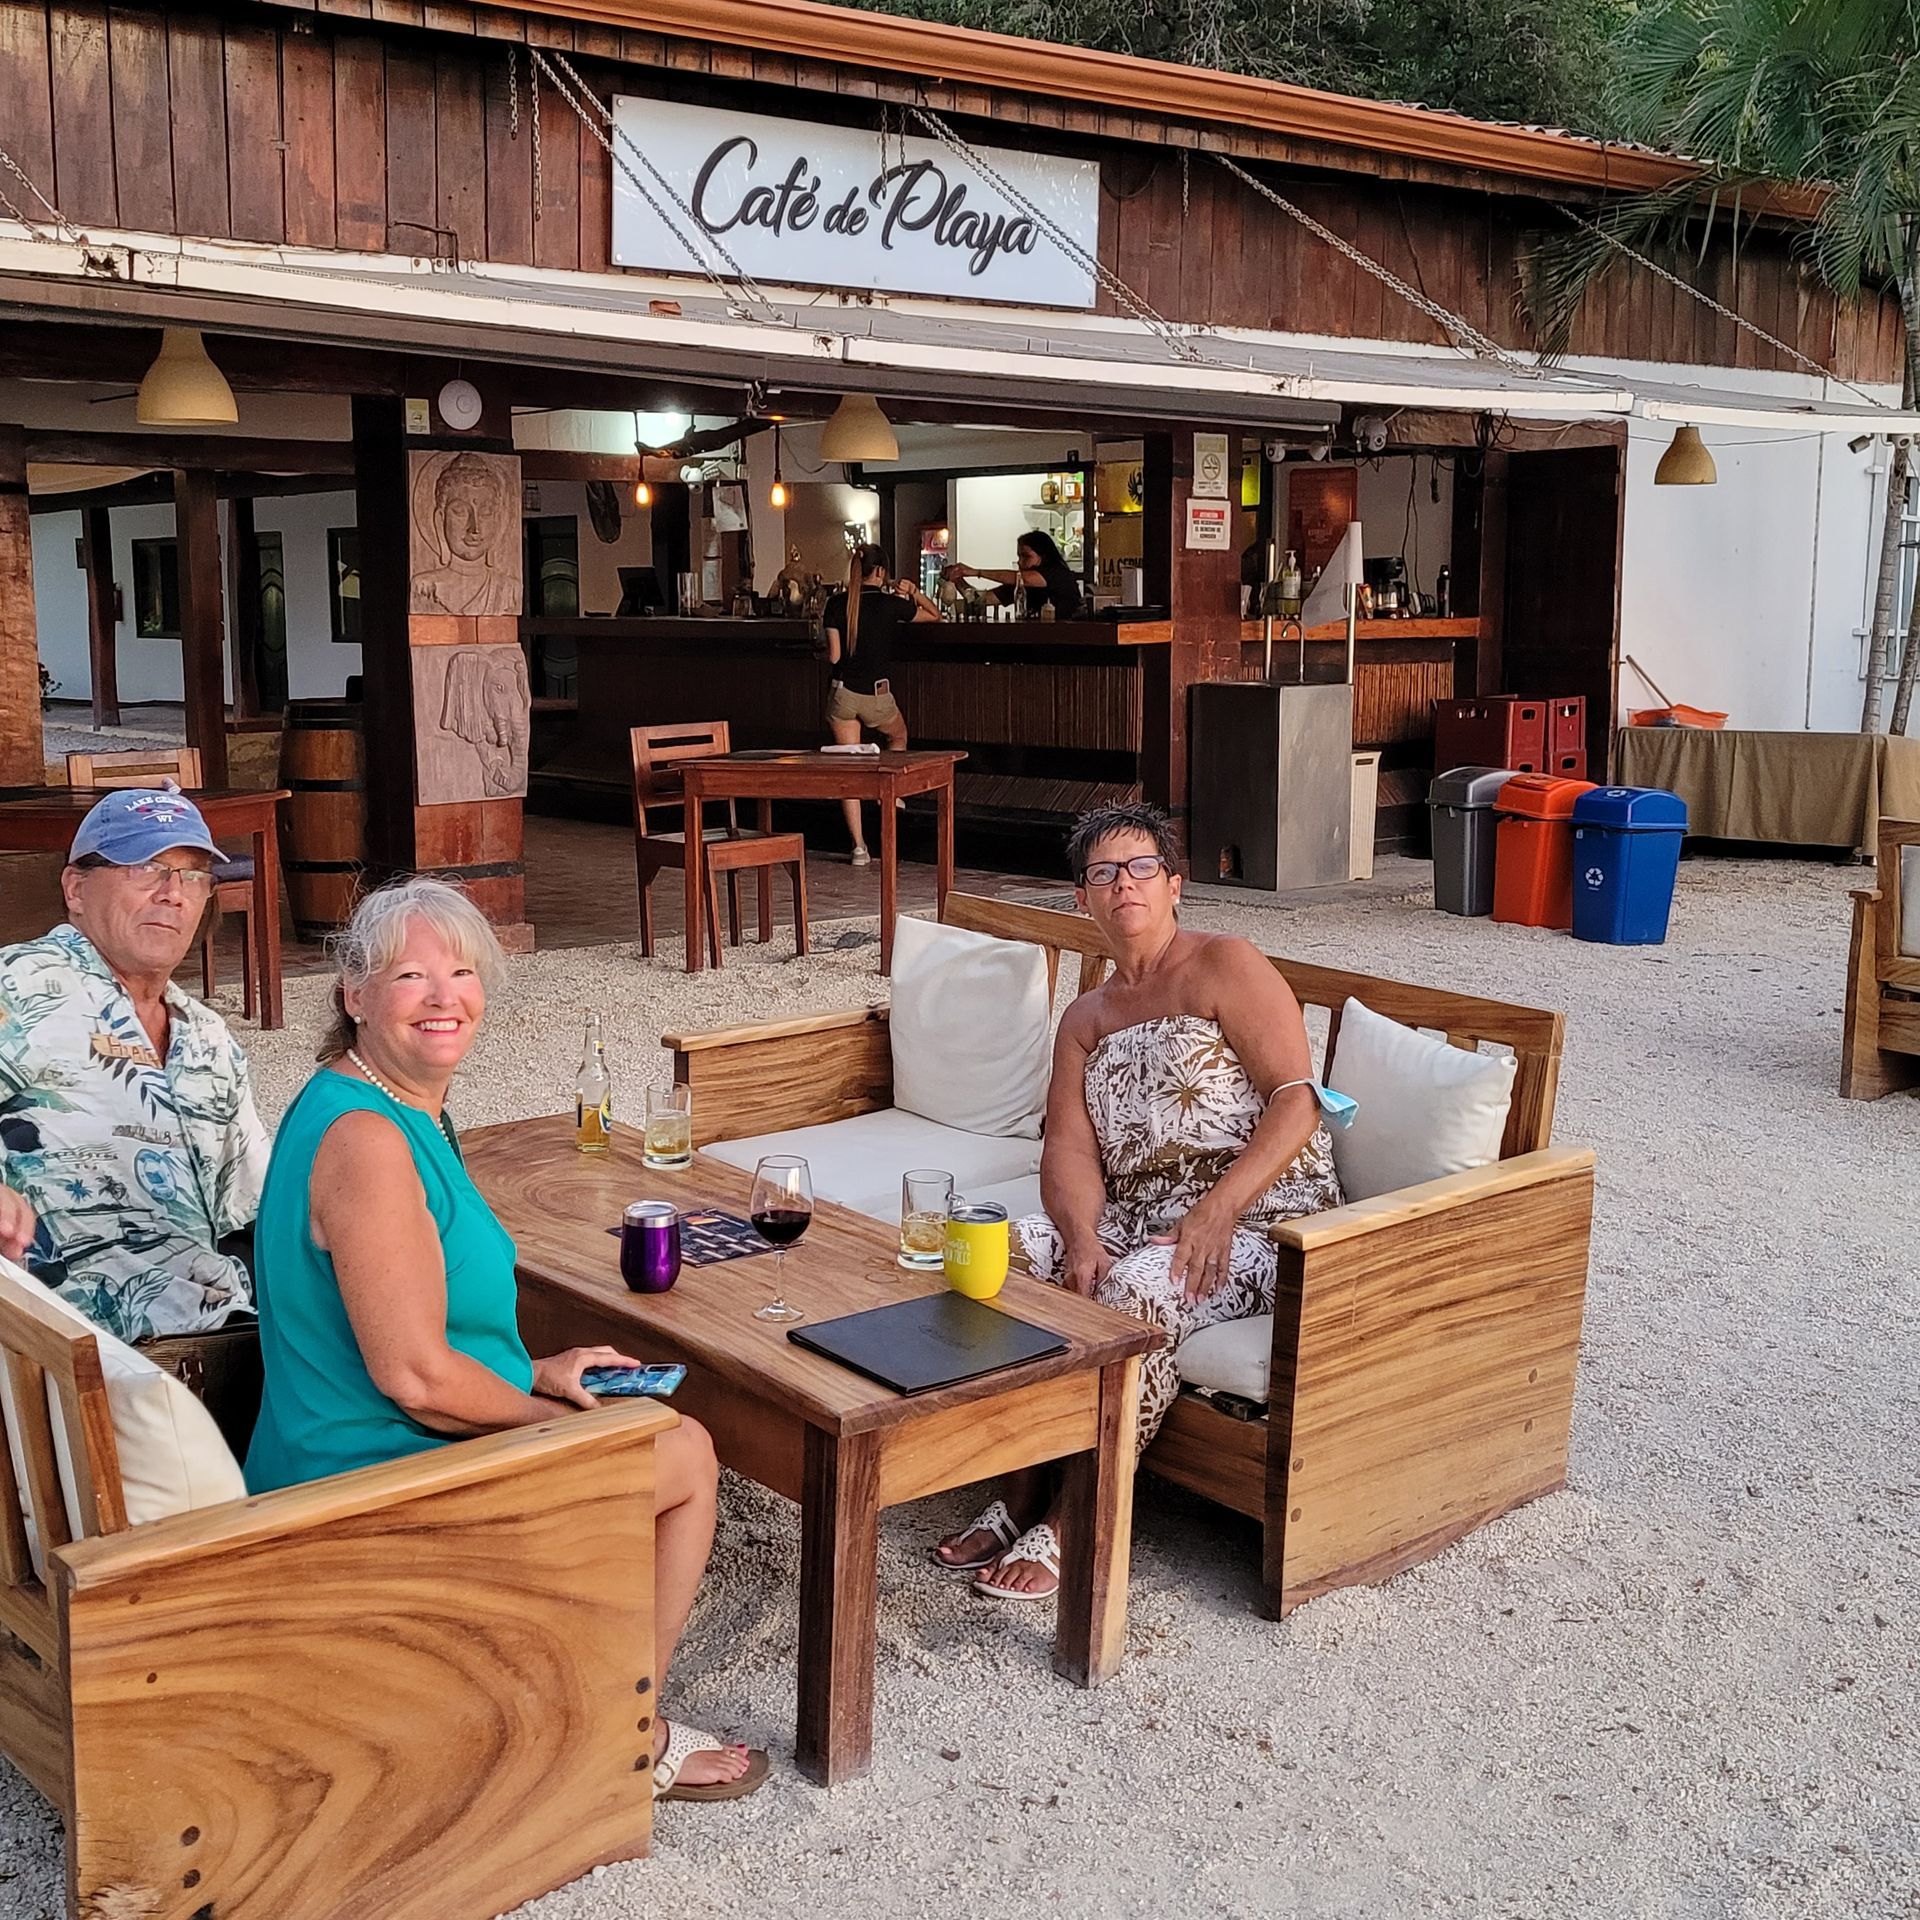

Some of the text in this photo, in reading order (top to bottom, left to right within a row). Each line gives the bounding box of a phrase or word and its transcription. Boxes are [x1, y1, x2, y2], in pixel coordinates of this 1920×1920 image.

[691, 135, 1038, 276] Café de Playa
[124, 796, 154, 812] LAKE
[156, 815, 173, 823] WI
